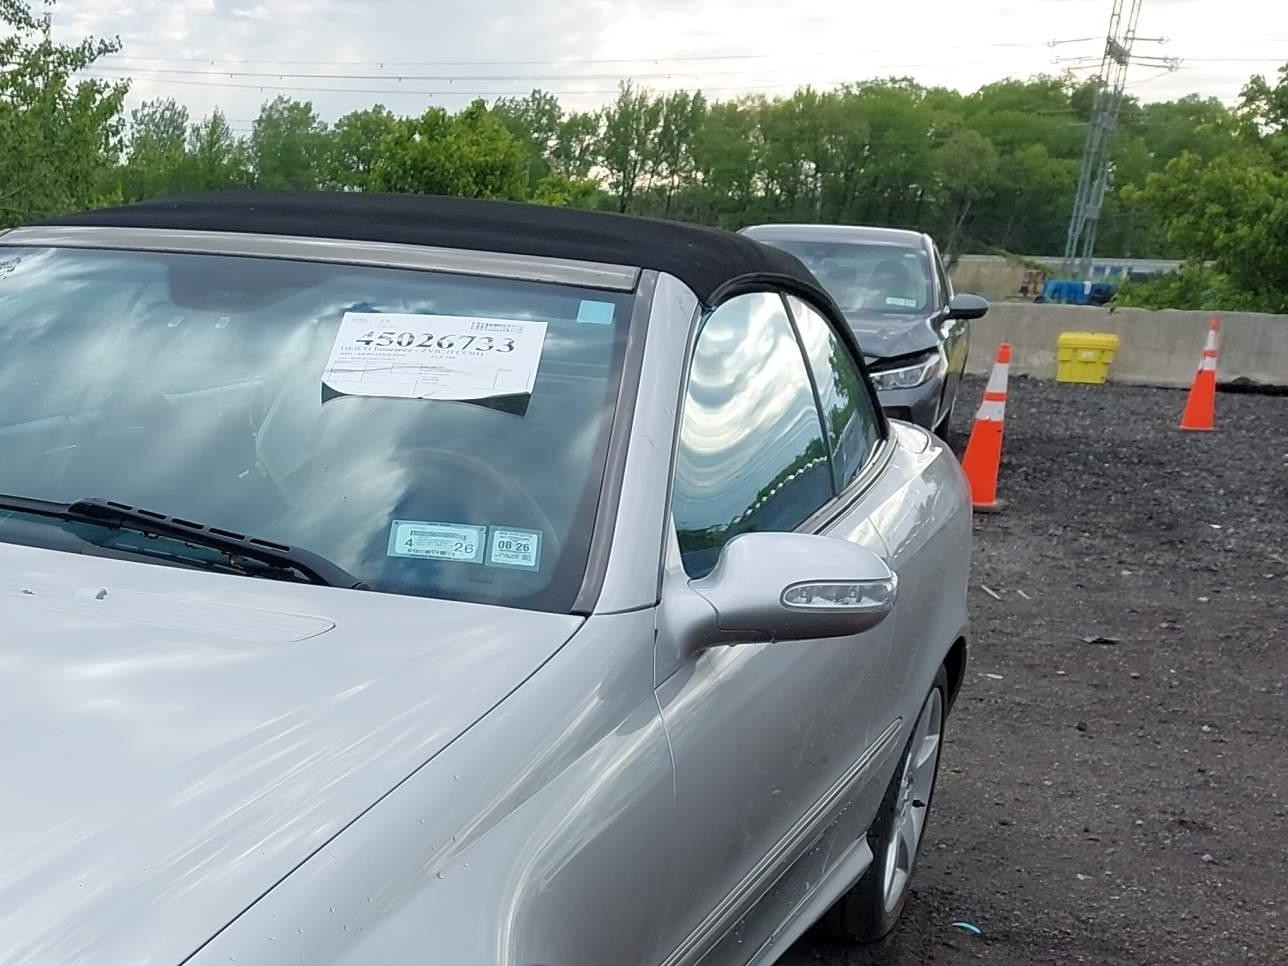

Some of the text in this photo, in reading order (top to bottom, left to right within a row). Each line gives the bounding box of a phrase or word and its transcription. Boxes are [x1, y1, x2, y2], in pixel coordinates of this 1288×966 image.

[355, 330, 516, 353] 45026733
[404, 537, 475, 554] 4 26
